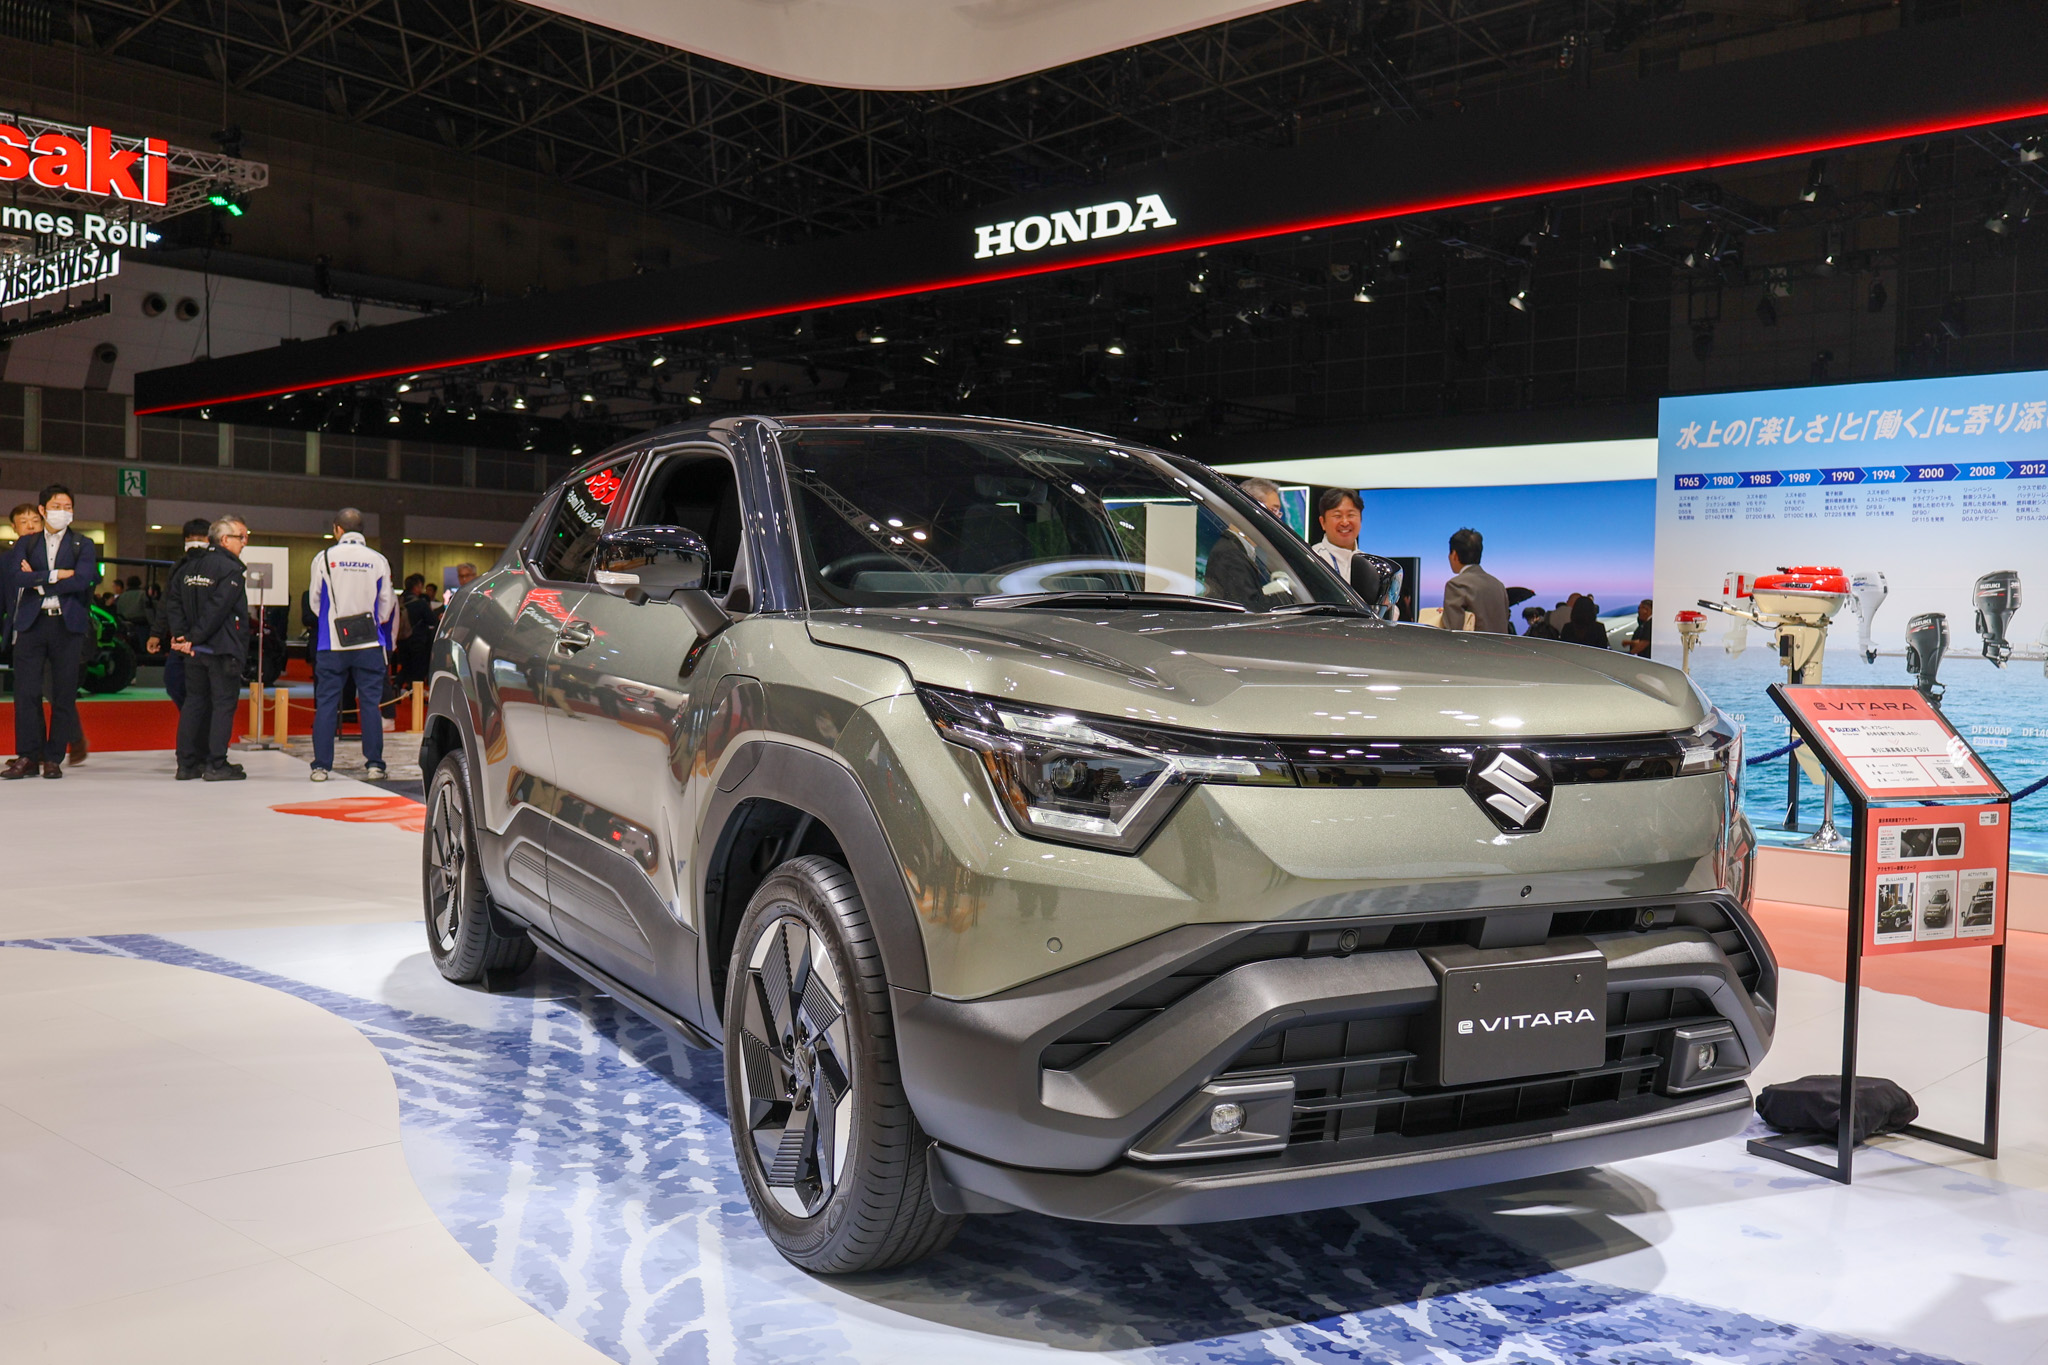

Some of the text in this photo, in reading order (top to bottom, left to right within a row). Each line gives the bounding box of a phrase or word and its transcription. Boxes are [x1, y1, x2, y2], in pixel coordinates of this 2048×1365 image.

[0, 124, 168, 206] saki
[2, 206, 74, 237] mes
[974, 194, 1177, 259] HONDA
[1675, 401, 2048, 450] 水上の「楽しさ」と「働く」に寄り添
[1678, 464, 2046, 487] 1965 1980 1985 1989 1990 1994 2000 2008 2012
[1829, 702, 1917, 711] VITARA
[1971, 726, 2012, 735] DF300AP
[2022, 728, 2048, 737] DF14
[1480, 1008, 1595, 1032] VITARA
